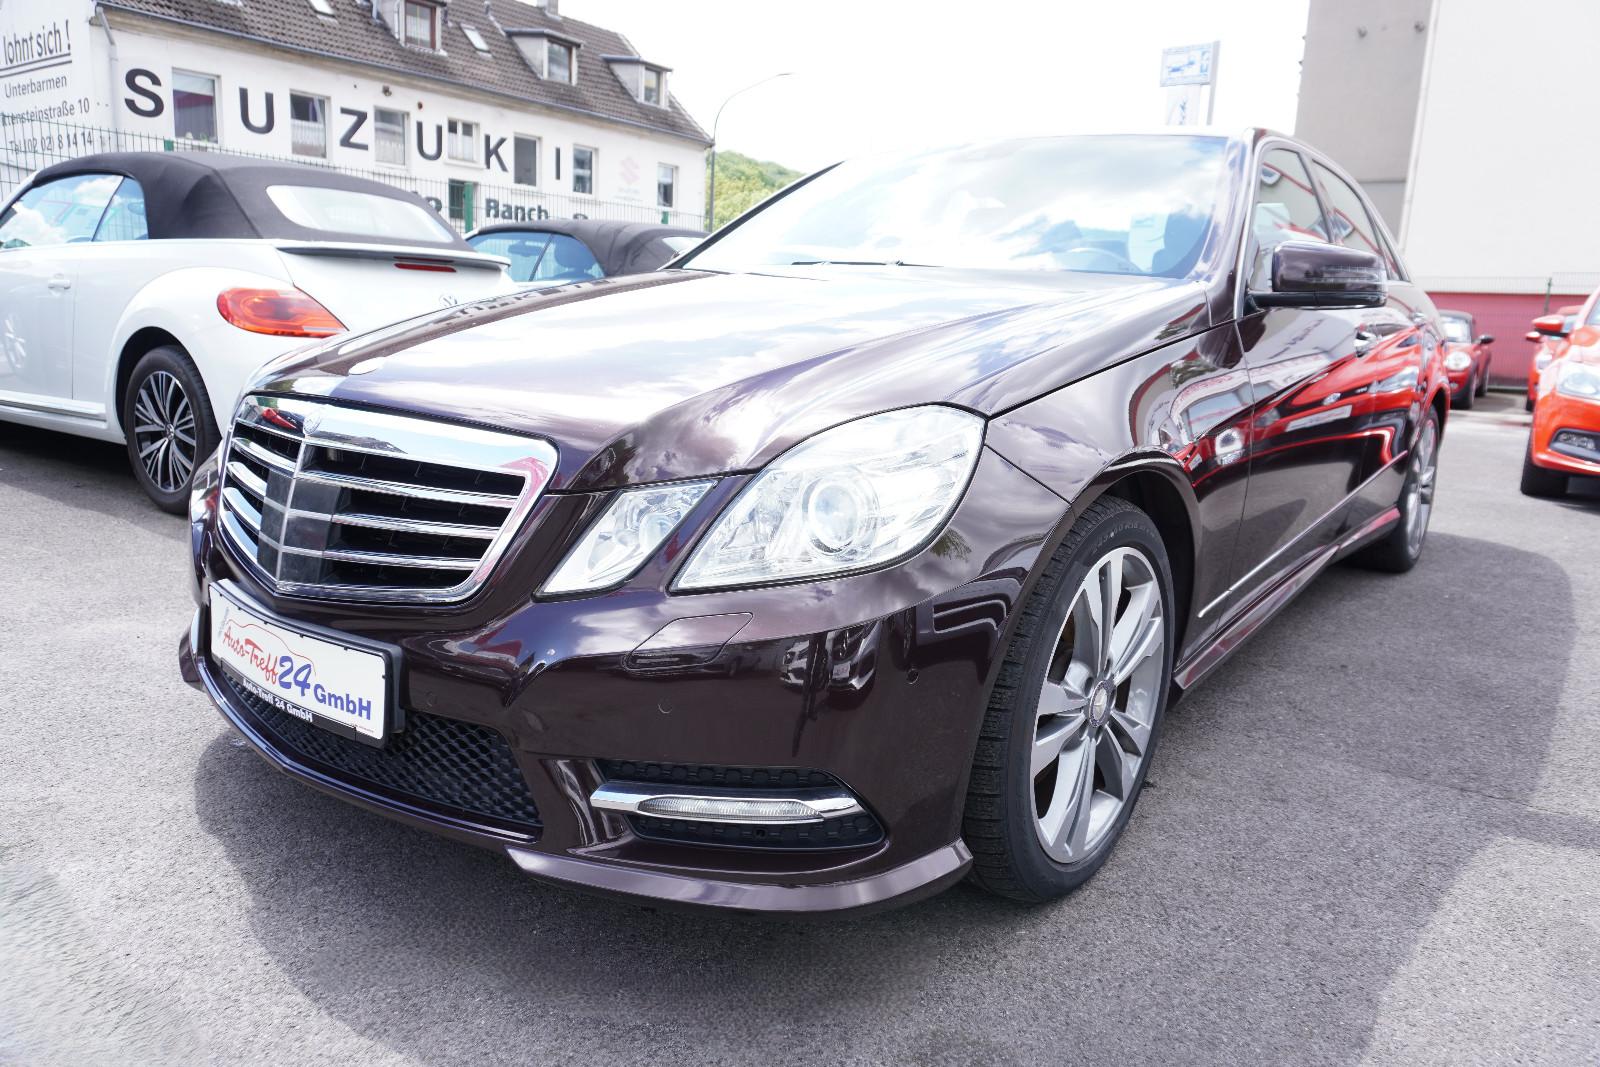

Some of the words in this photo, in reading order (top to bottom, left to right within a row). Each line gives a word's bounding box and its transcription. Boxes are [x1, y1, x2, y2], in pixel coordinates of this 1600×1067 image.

[3, 32, 34, 65] lohnt
[36, 21, 62, 58] sich
[4, 75, 67, 98] Unterbarmen
[78, 97, 90, 114] 10
[124, 67, 561, 182] SUZUKI
[58, 134, 64, 150] 8
[81, 130, 92, 146] 14
[485, 198, 549, 221] Ranch
[223, 626, 279, 685] Auto-Treff
[278, 655, 312, 697] 24
[313, 683, 372, 720] GmbH
[275, 698, 285, 711] 24
[286, 704, 314, 723] GmbH
